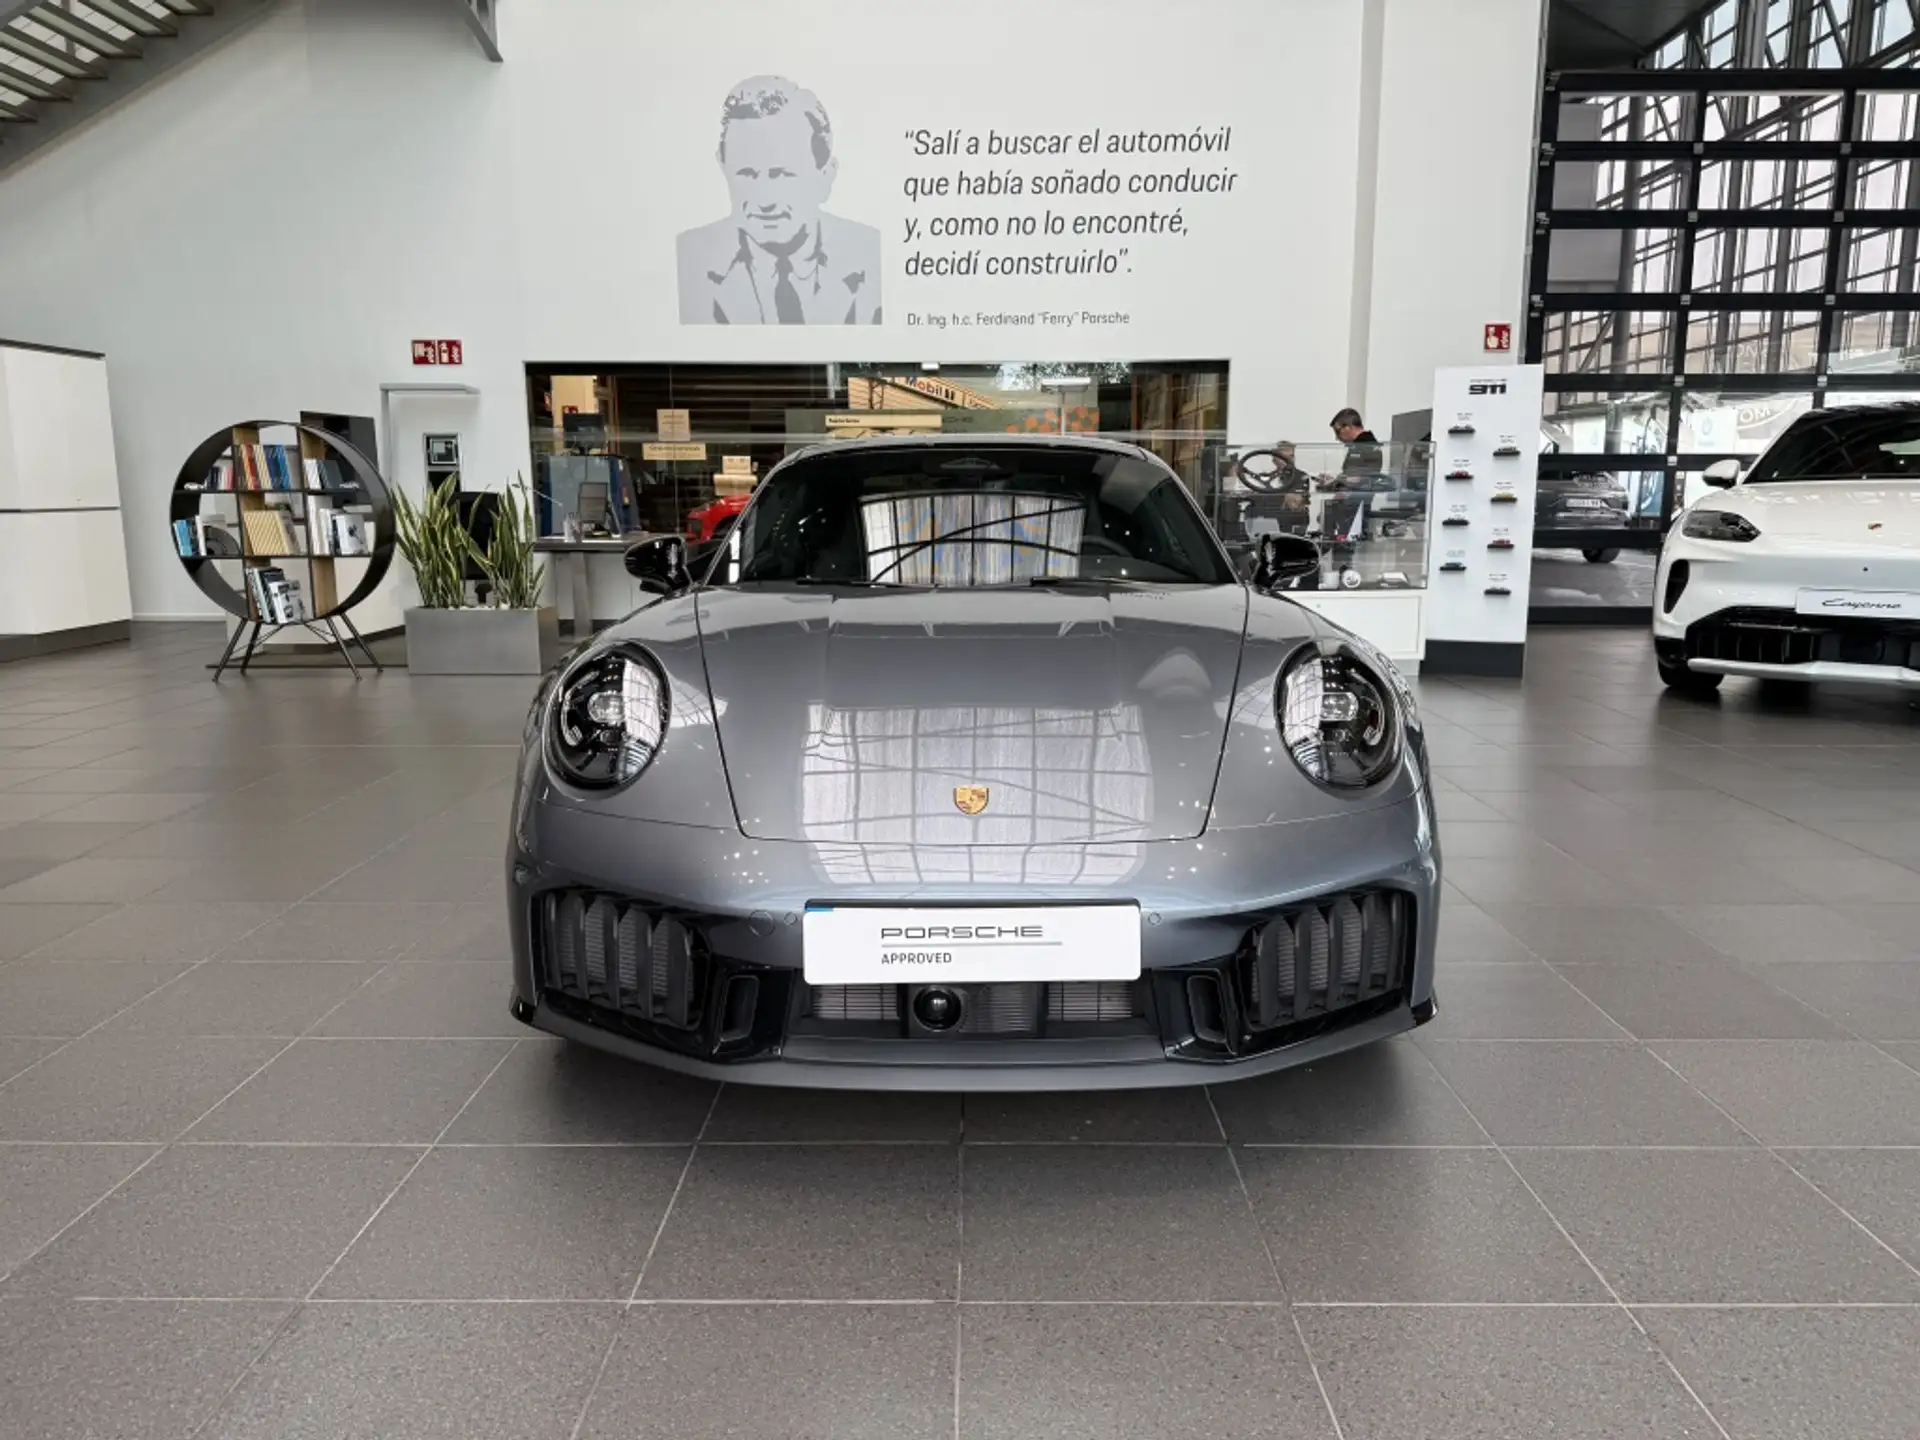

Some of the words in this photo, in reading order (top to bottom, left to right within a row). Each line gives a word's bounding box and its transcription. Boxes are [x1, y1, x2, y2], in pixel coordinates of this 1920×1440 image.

[966, 136, 980, 156] a
[987, 129, 1073, 156] buscar
[1078, 127, 1100, 154] el
[1106, 126, 1232, 154] automóvil
[903, 176, 950, 203] que
[956, 169, 1024, 196] había
[1030, 168, 1121, 195] soñado
[1128, 166, 1239, 194] conducir
[903, 217, 922, 244] y,
[929, 216, 1000, 237] como
[1006, 215, 1037, 236] no
[1044, 209, 1065, 236] lo
[1072, 207, 1189, 237] encontré,
[904, 249, 980, 277] decidí
[907, 312, 924, 326] Dr.
[927, 313, 948, 330] Ing.
[951, 312, 973, 326] h.c.
[975, 311, 1035, 326] Ferdinand
[1081, 310, 1131, 325] Porsche
[1468, 383, 1507, 395] 911
[880, 925, 1043, 939] PORSCHE
[881, 952, 952, 965] APPROVED
